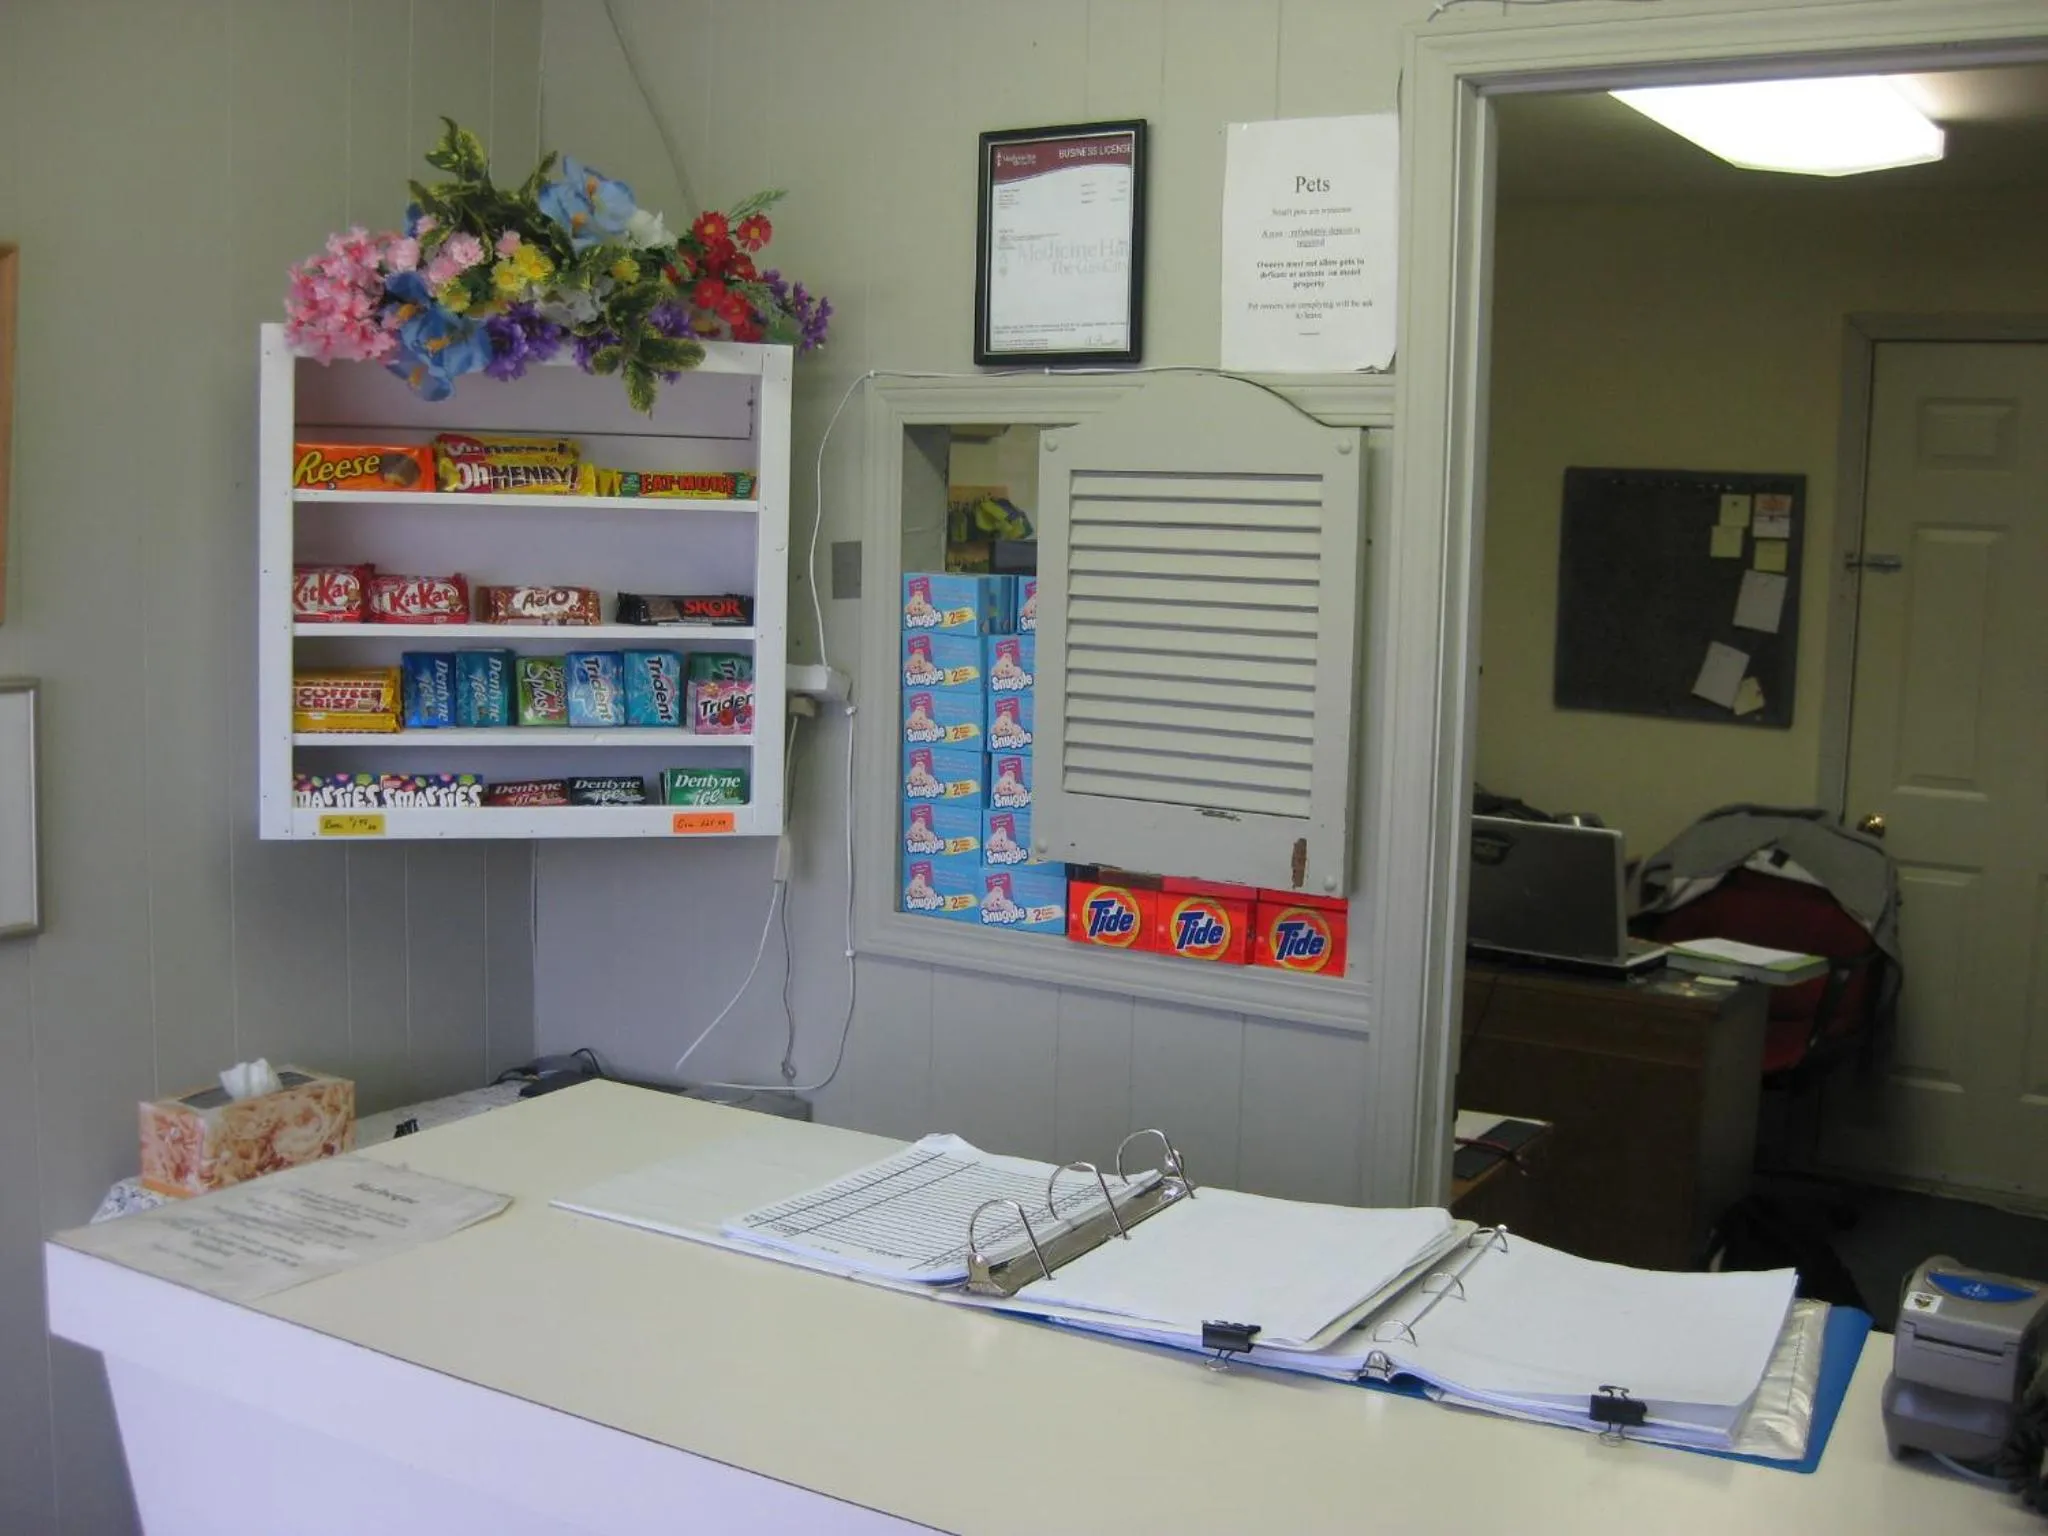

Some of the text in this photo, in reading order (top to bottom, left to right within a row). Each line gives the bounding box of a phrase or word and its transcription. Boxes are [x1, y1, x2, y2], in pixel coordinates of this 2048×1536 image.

[1059, 146, 1097, 160] BUSINESS
[1296, 175, 1331, 194] Pets
[294, 450, 381, 488] Reese
[456, 462, 491, 490] Oh
[522, 590, 569, 609] Aero
[684, 600, 741, 617] SKOR
[906, 610, 942, 628] Snuggle
[950, 612, 956, 625] 2
[906, 669, 944, 685] Snuggle
[952, 670, 959, 682] 2
[992, 673, 1033, 691] Snuggle
[299, 688, 370, 699] COFFEE
[435, 658, 449, 722] Dentyne
[488, 656, 502, 722] Dentyne
[583, 657, 613, 720] Trident
[647, 656, 673, 721] Trident
[299, 698, 358, 709] CRISP
[907, 727, 945, 742] Snuggle
[953, 728, 960, 740] 2
[991, 731, 1032, 749] Snuggle
[496, 781, 562, 795] Dentyne
[574, 779, 640, 790] Dentyne
[674, 774, 741, 788] Dentyne
[953, 783, 960, 796] 2
[294, 782, 381, 808] MARTIES
[383, 783, 482, 808] SMARTIES
[907, 782, 945, 798] Snuggle
[993, 789, 1032, 808] Snuggl
[907, 838, 945, 855] Snuggle
[953, 840, 960, 853] 2
[986, 847, 1028, 865] Snuggle
[907, 894, 944, 910] Snuggle
[951, 897, 959, 909] 2
[980, 906, 1026, 923] Snuggle
[1034, 908, 1042, 921] 2
[1088, 899, 1134, 937] Tide
[1177, 911, 1224, 950] Tide
[1275, 922, 1324, 961] Tide
